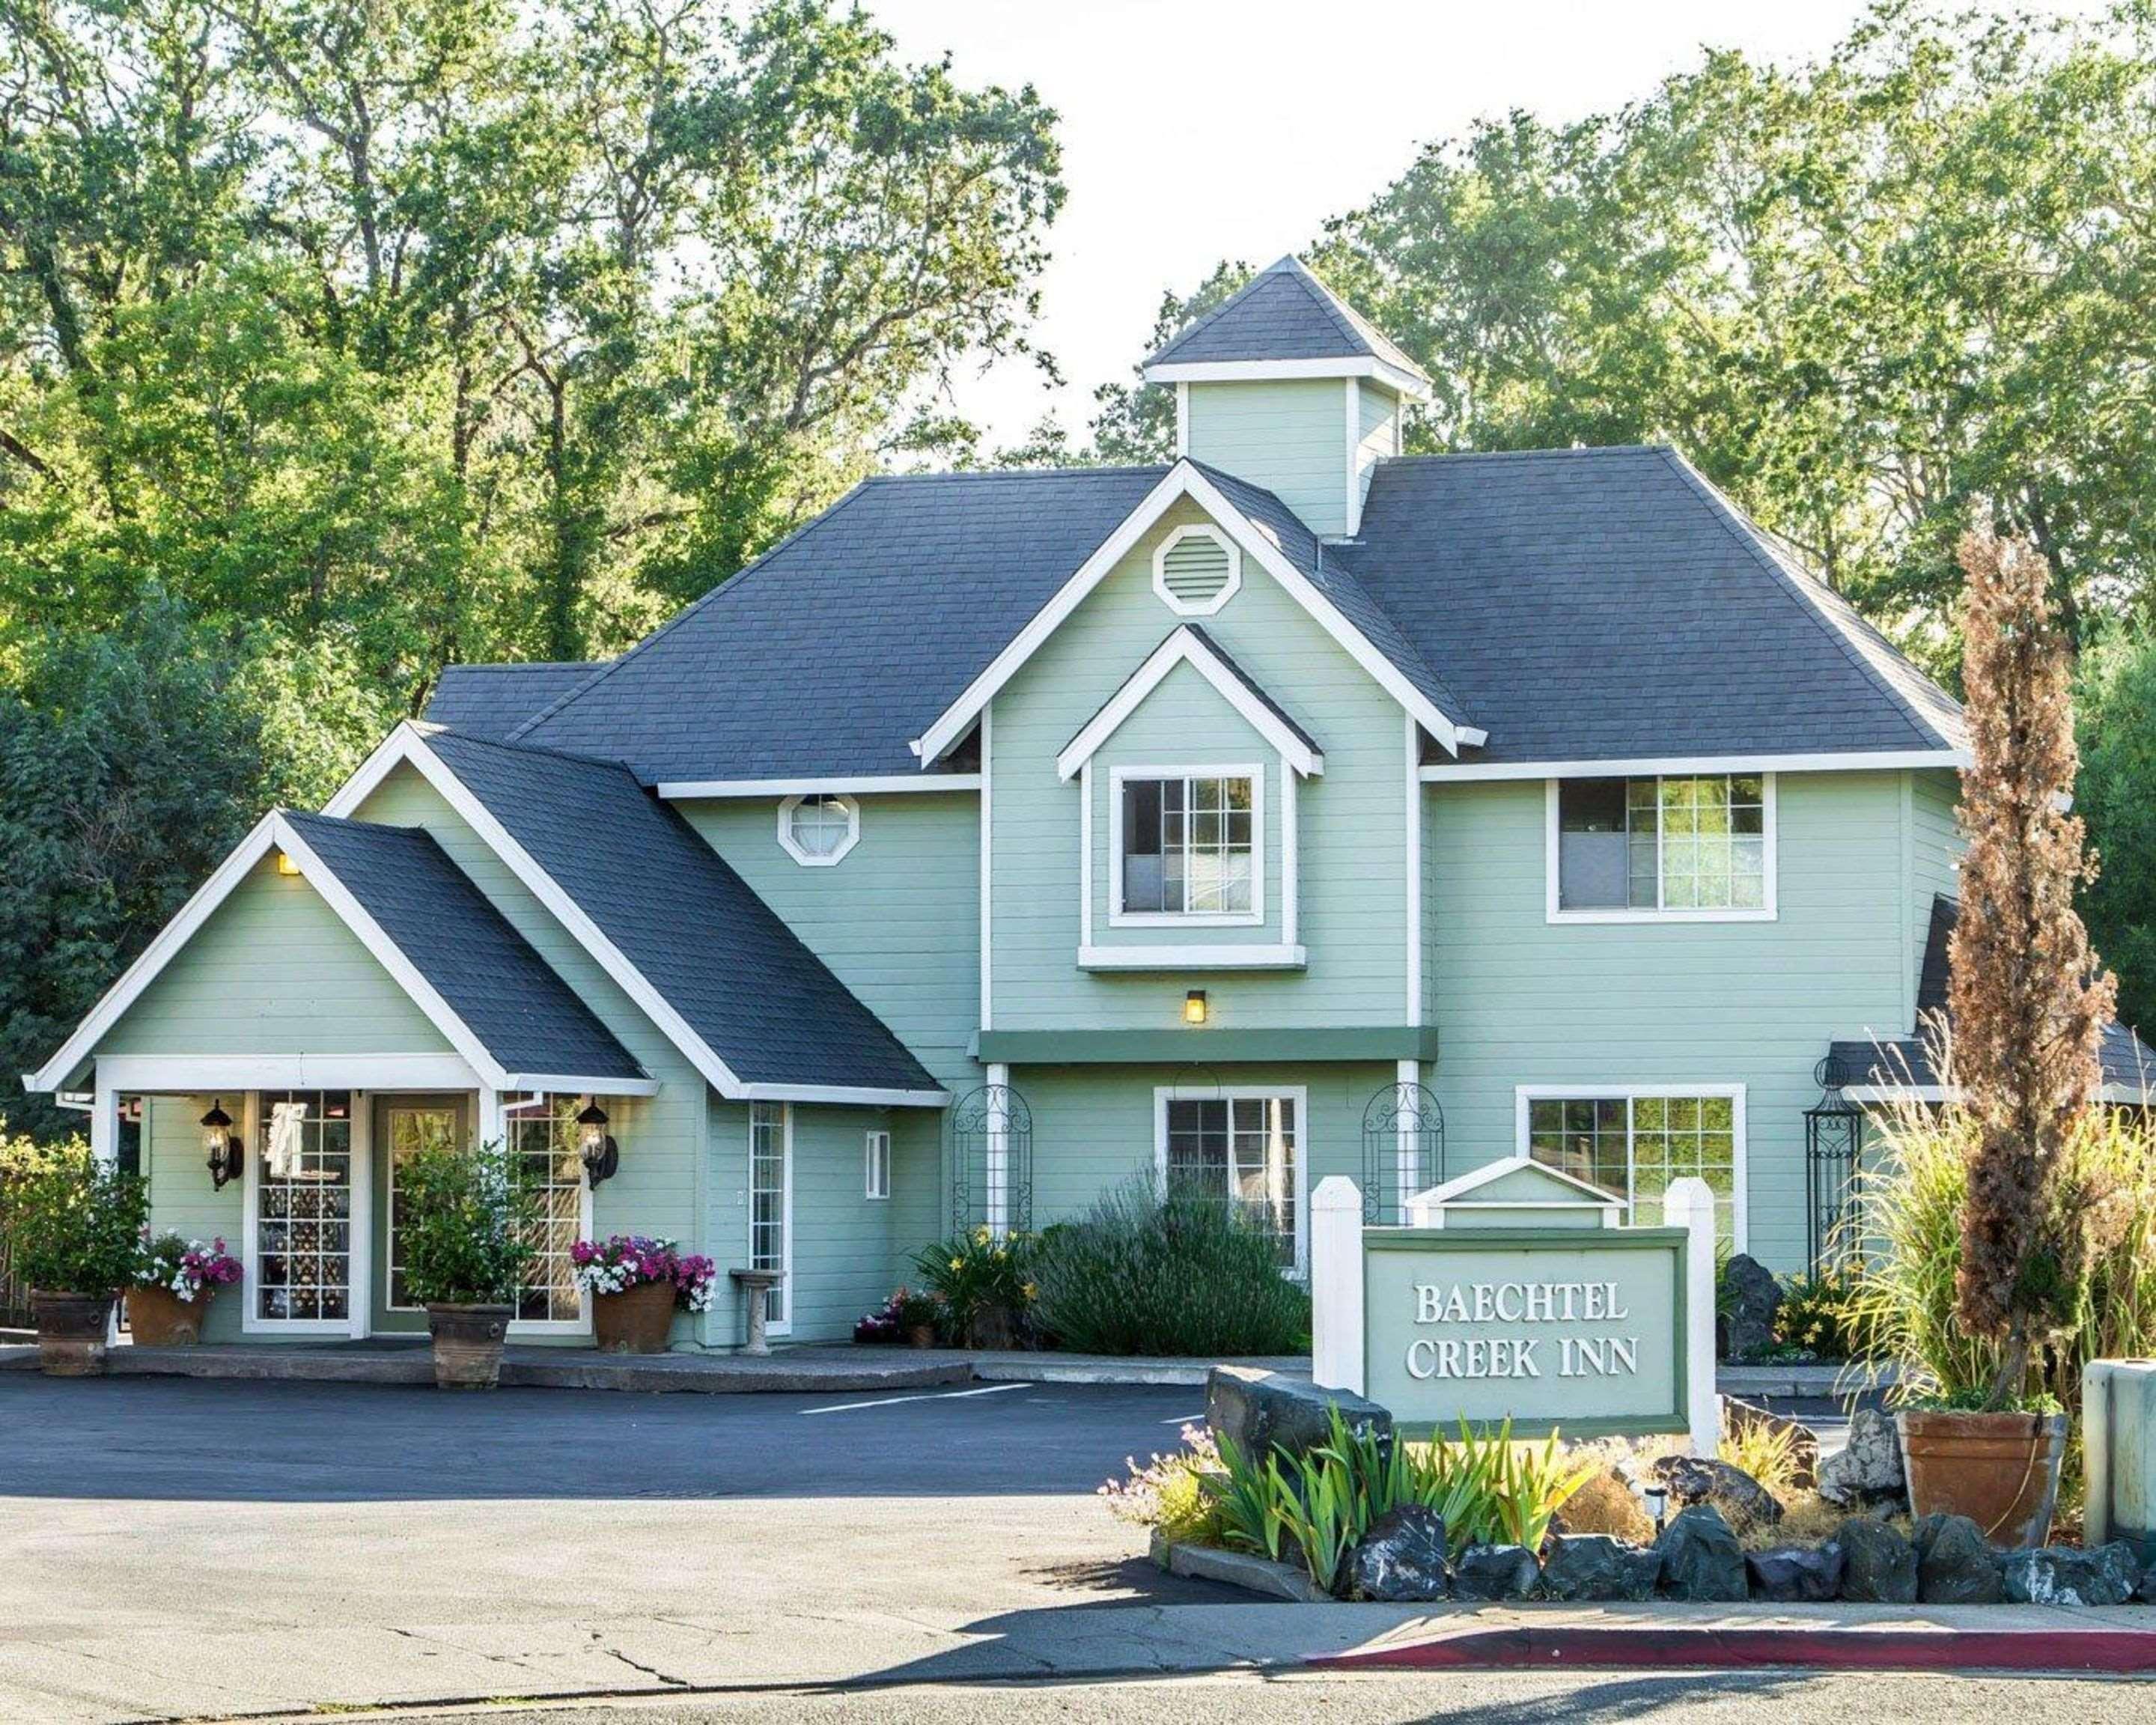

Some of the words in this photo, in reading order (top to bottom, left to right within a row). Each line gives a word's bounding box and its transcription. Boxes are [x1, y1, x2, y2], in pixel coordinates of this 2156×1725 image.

[1414, 1282, 1629, 1323] BAECHTEL
[1406, 1339, 1540, 1379] CREEK
[1558, 1337, 1639, 1377] INN
